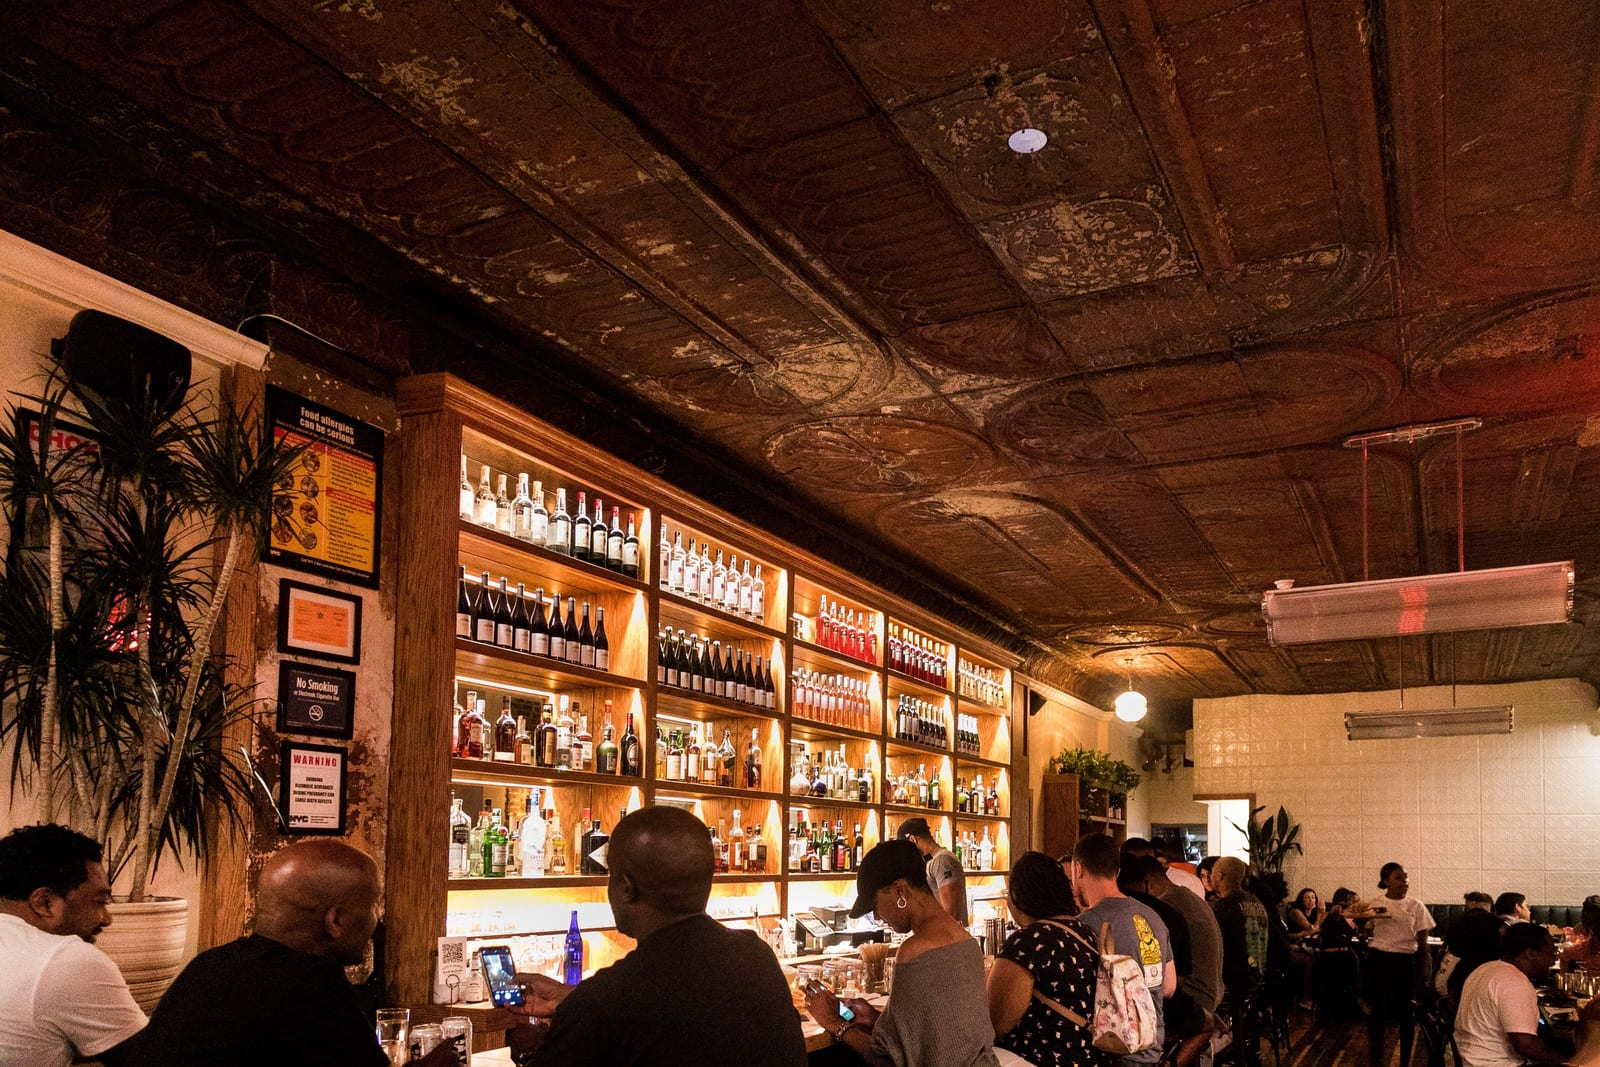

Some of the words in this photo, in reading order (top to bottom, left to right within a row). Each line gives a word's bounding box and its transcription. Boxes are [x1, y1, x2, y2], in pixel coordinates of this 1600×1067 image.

[300, 406, 319, 420] Food
[320, 416, 354, 435] allergies
[300, 418, 315, 430] can
[316, 423, 325, 434] be
[327, 428, 355, 445] serious
[296, 677, 306, 688] No
[308, 679, 338, 695] Smoking
[293, 754, 337, 767] WARNING
[289, 815, 308, 823] NYC
